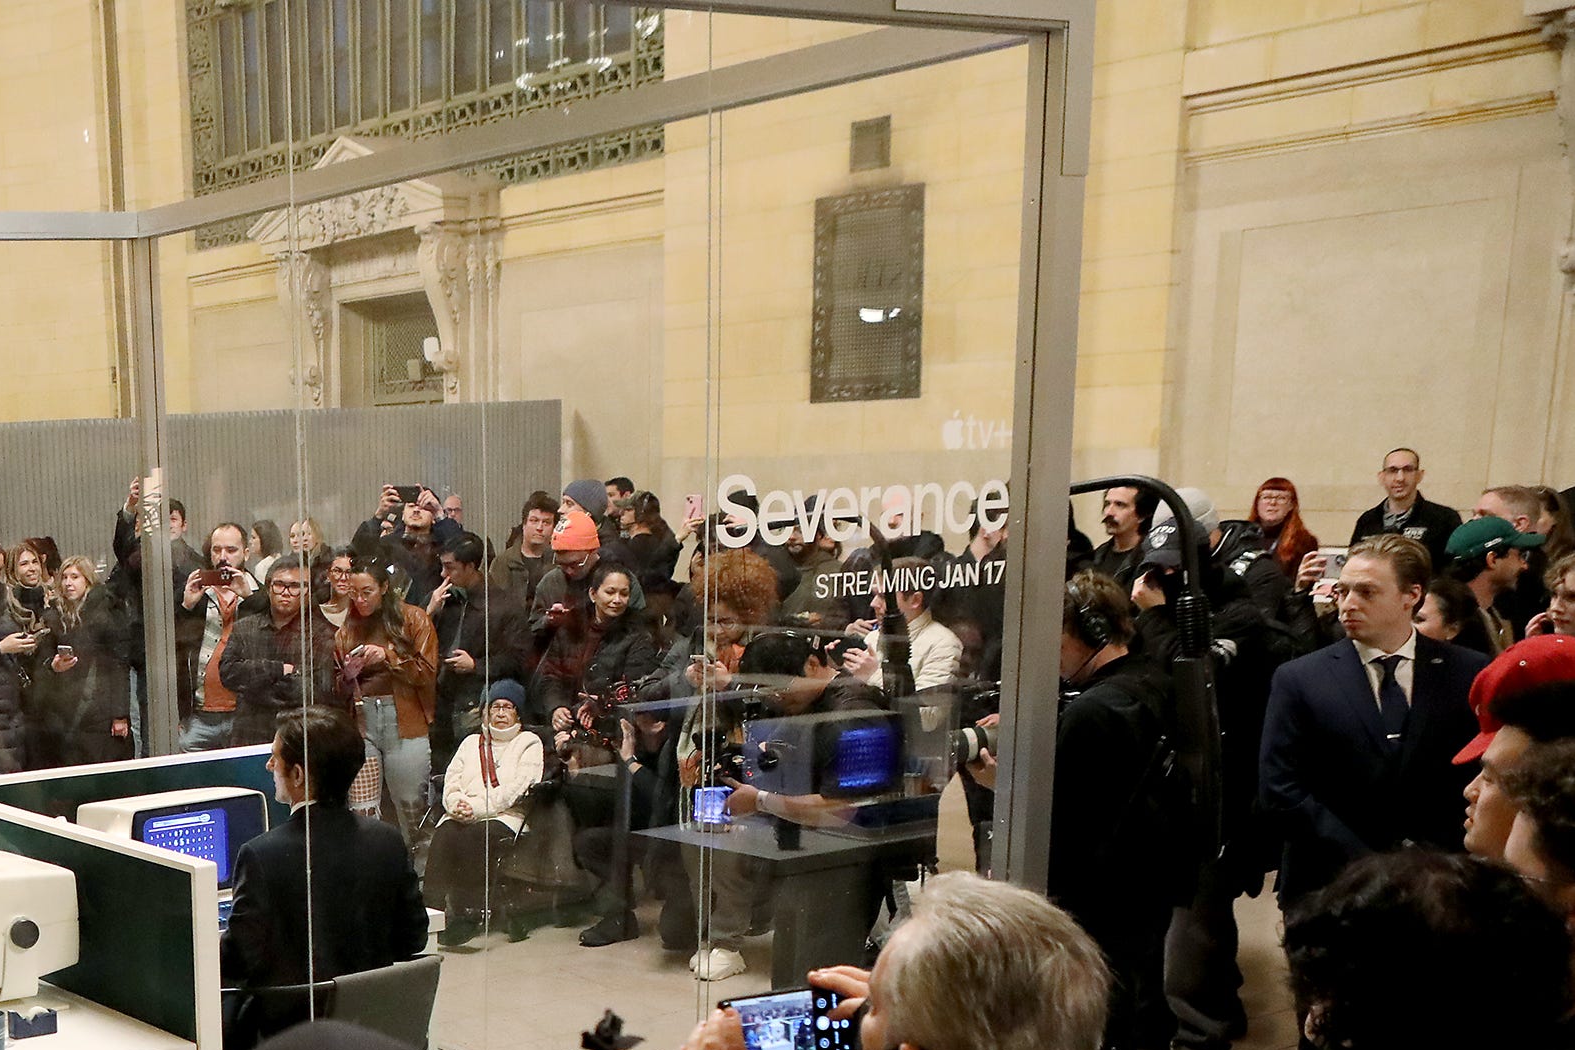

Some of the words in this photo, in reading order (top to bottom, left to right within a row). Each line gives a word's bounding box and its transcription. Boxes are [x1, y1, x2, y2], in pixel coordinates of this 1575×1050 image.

[715, 474, 1010, 549] Severance
[815, 566, 936, 599] STREAMING
[938, 562, 980, 590] JAN
[983, 560, 1006, 585] 17
